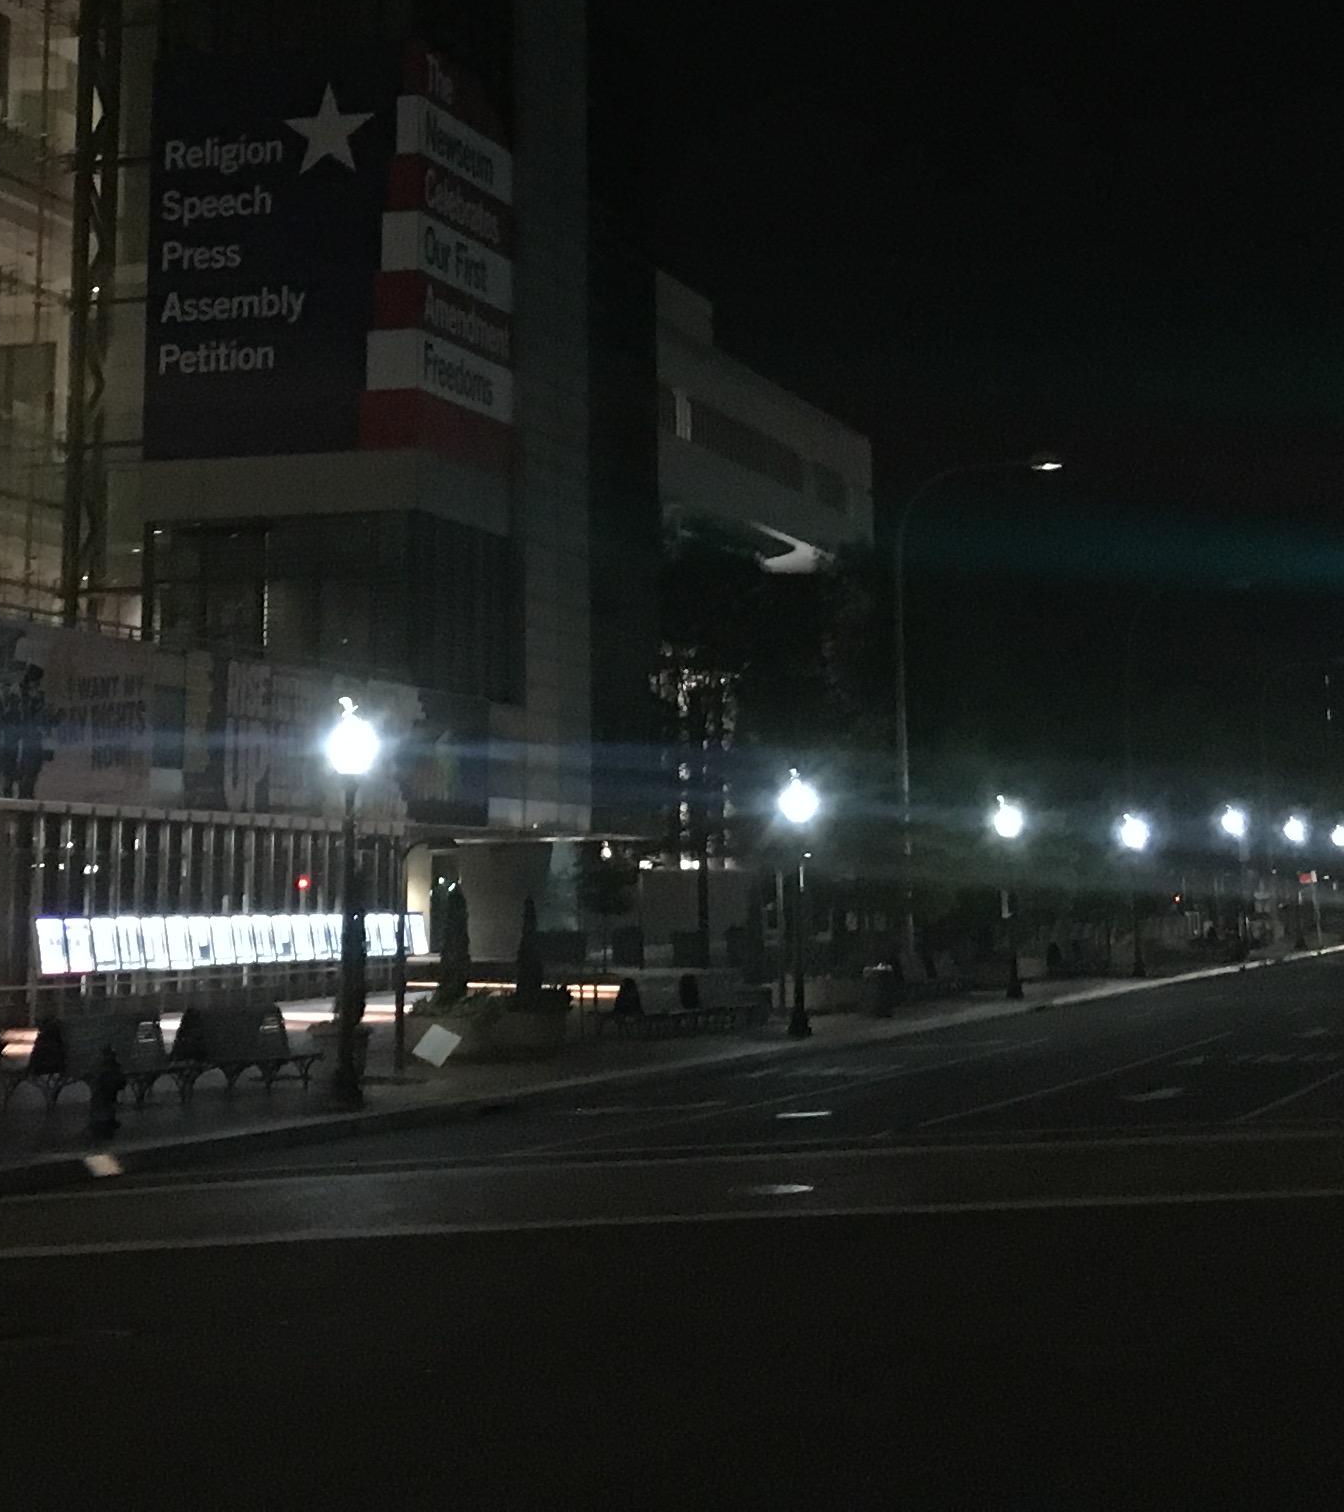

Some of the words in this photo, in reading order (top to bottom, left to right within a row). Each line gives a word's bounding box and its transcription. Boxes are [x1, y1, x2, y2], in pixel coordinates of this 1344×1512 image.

[163, 135, 284, 175] Religion
[161, 185, 273, 226] Speech
[161, 240, 242, 272] Press
[424, 225, 452, 274] Our
[454, 240, 488, 294] First
[160, 285, 306, 324] Assembly
[158, 341, 276, 375] Petition
